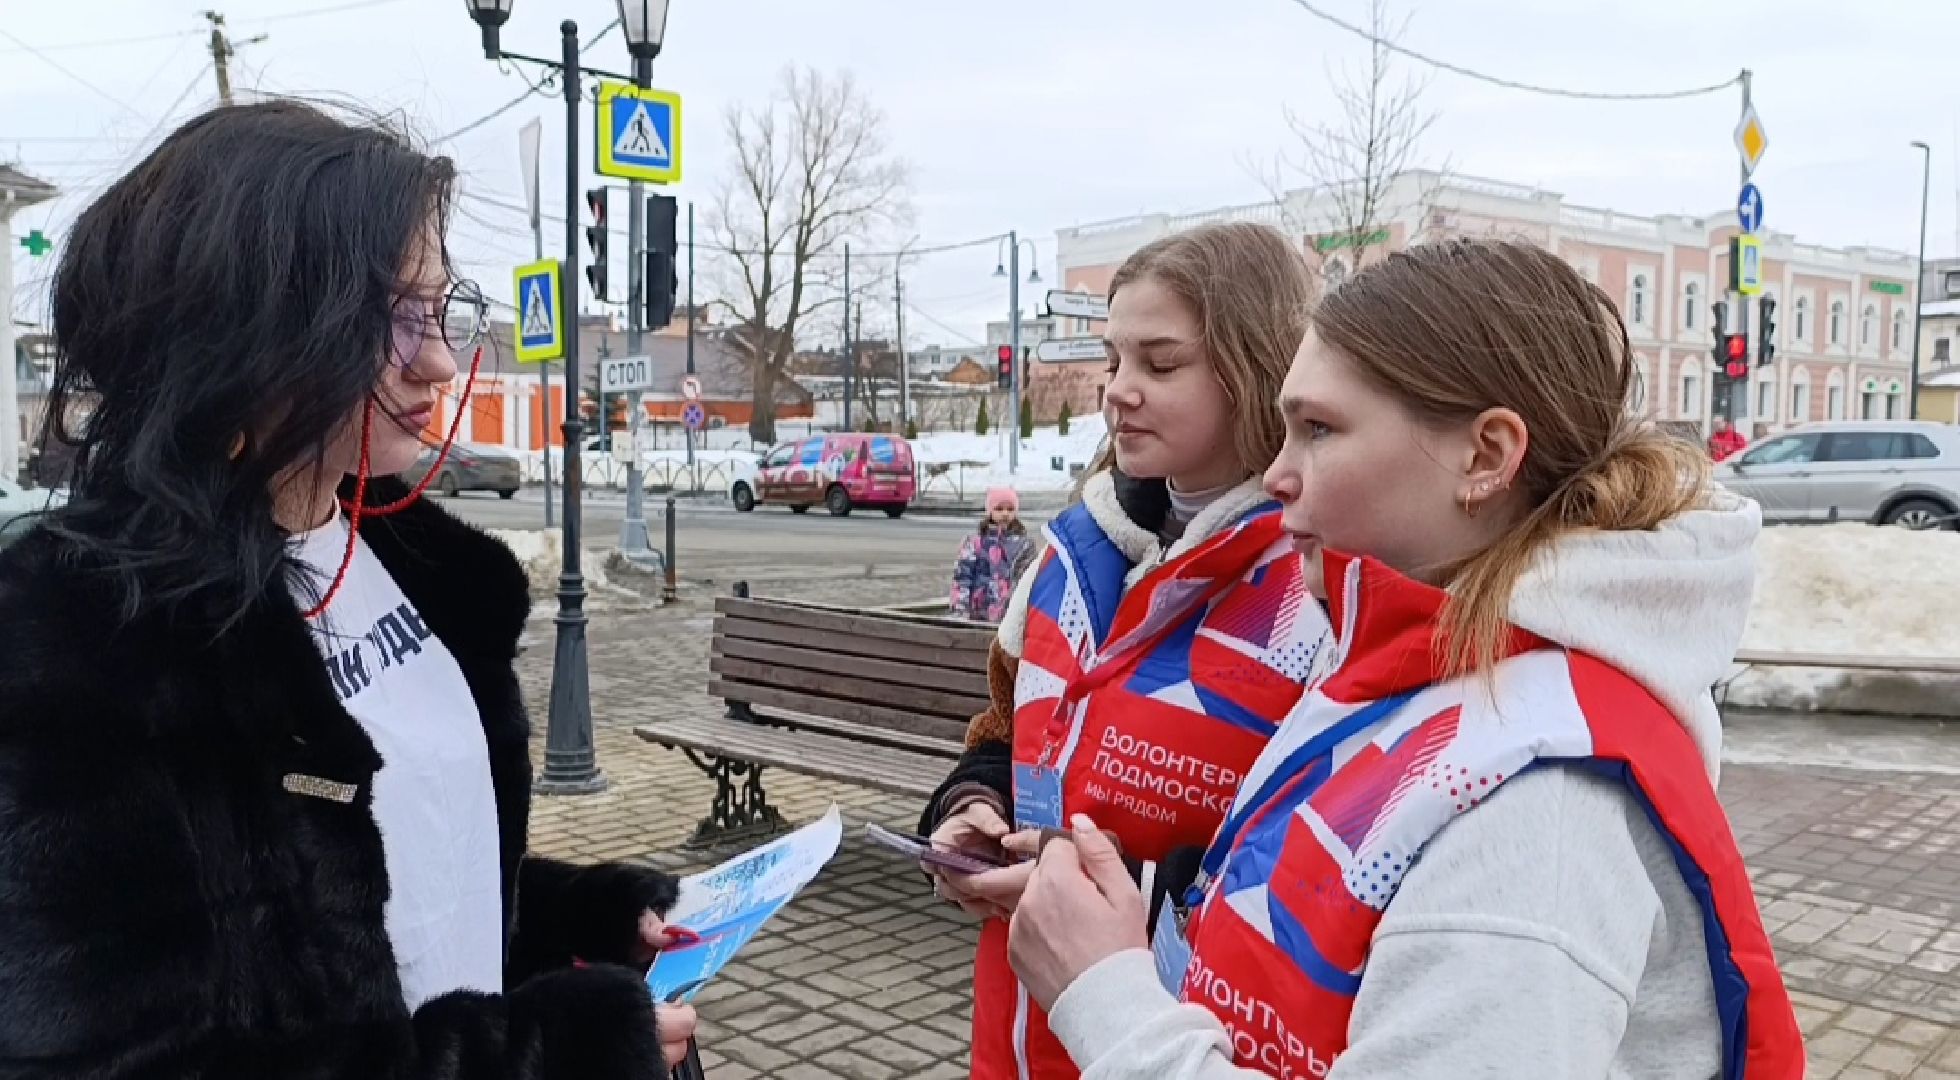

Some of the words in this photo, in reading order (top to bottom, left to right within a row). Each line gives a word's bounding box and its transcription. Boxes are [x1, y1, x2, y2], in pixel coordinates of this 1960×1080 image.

[607, 361, 647, 386] СТОП
[1084, 780, 1111, 803] МЫ
[1113, 790, 1177, 825] РЯДОМ
